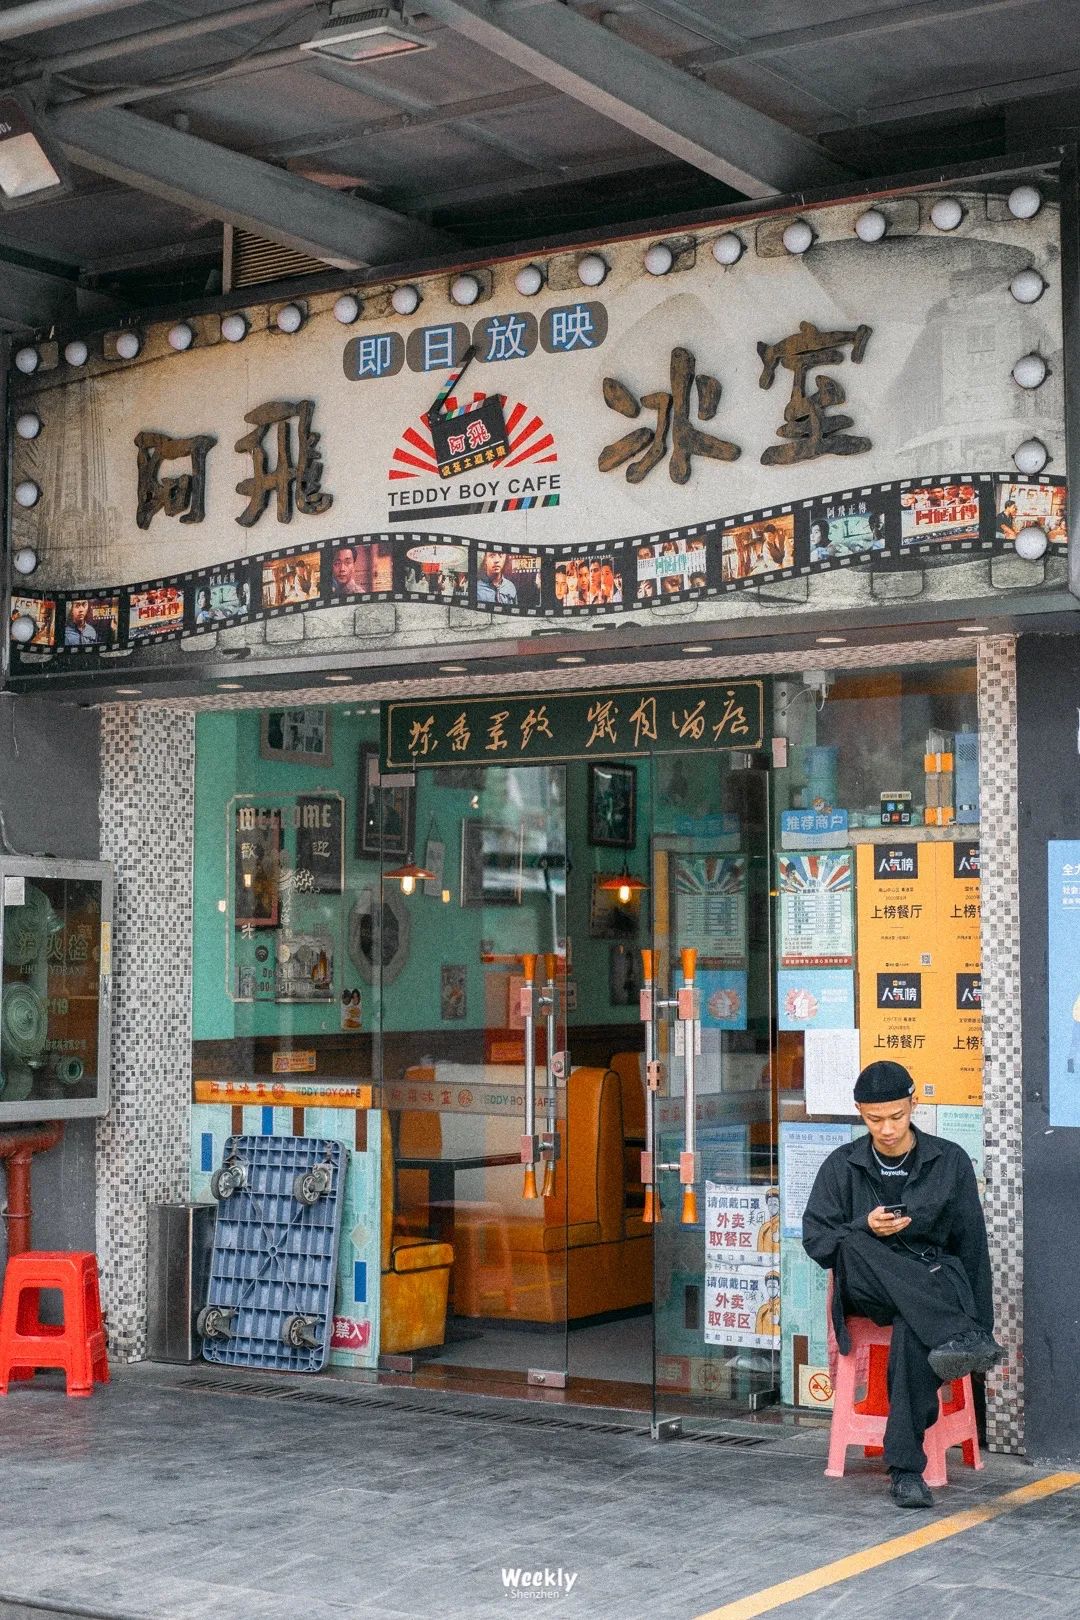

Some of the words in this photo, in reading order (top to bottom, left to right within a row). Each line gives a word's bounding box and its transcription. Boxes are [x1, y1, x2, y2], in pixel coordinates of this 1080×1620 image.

[357, 304, 593, 375] 即日放映
[598, 321, 872, 485] 冰室
[387, 486, 451, 507] TEDDY
[459, 480, 500, 500] BOY
[508, 474, 561, 494] CAFE
[786, 815, 844, 831] 推荐商户
[879, 858, 914, 872] 人气榜
[871, 904, 923, 919] 上榜餐厅
[882, 987, 917, 1002] 人气榜
[874, 1034, 926, 1049] 上榜餐厅
[953, 1035, 983, 1050] 上榜
[339, 1088, 361, 1098] CAFE
[707, 1197, 760, 1209] 请佩戴口罩
[717, 1212, 745, 1229] 外卖
[709, 1231, 752, 1247] 取餐区
[707, 1276, 759, 1291] 请佩戴口罩
[715, 1292, 744, 1310] 外卖
[708, 1311, 751, 1329] 取餐区
[336, 1320, 363, 1340] 禁入
